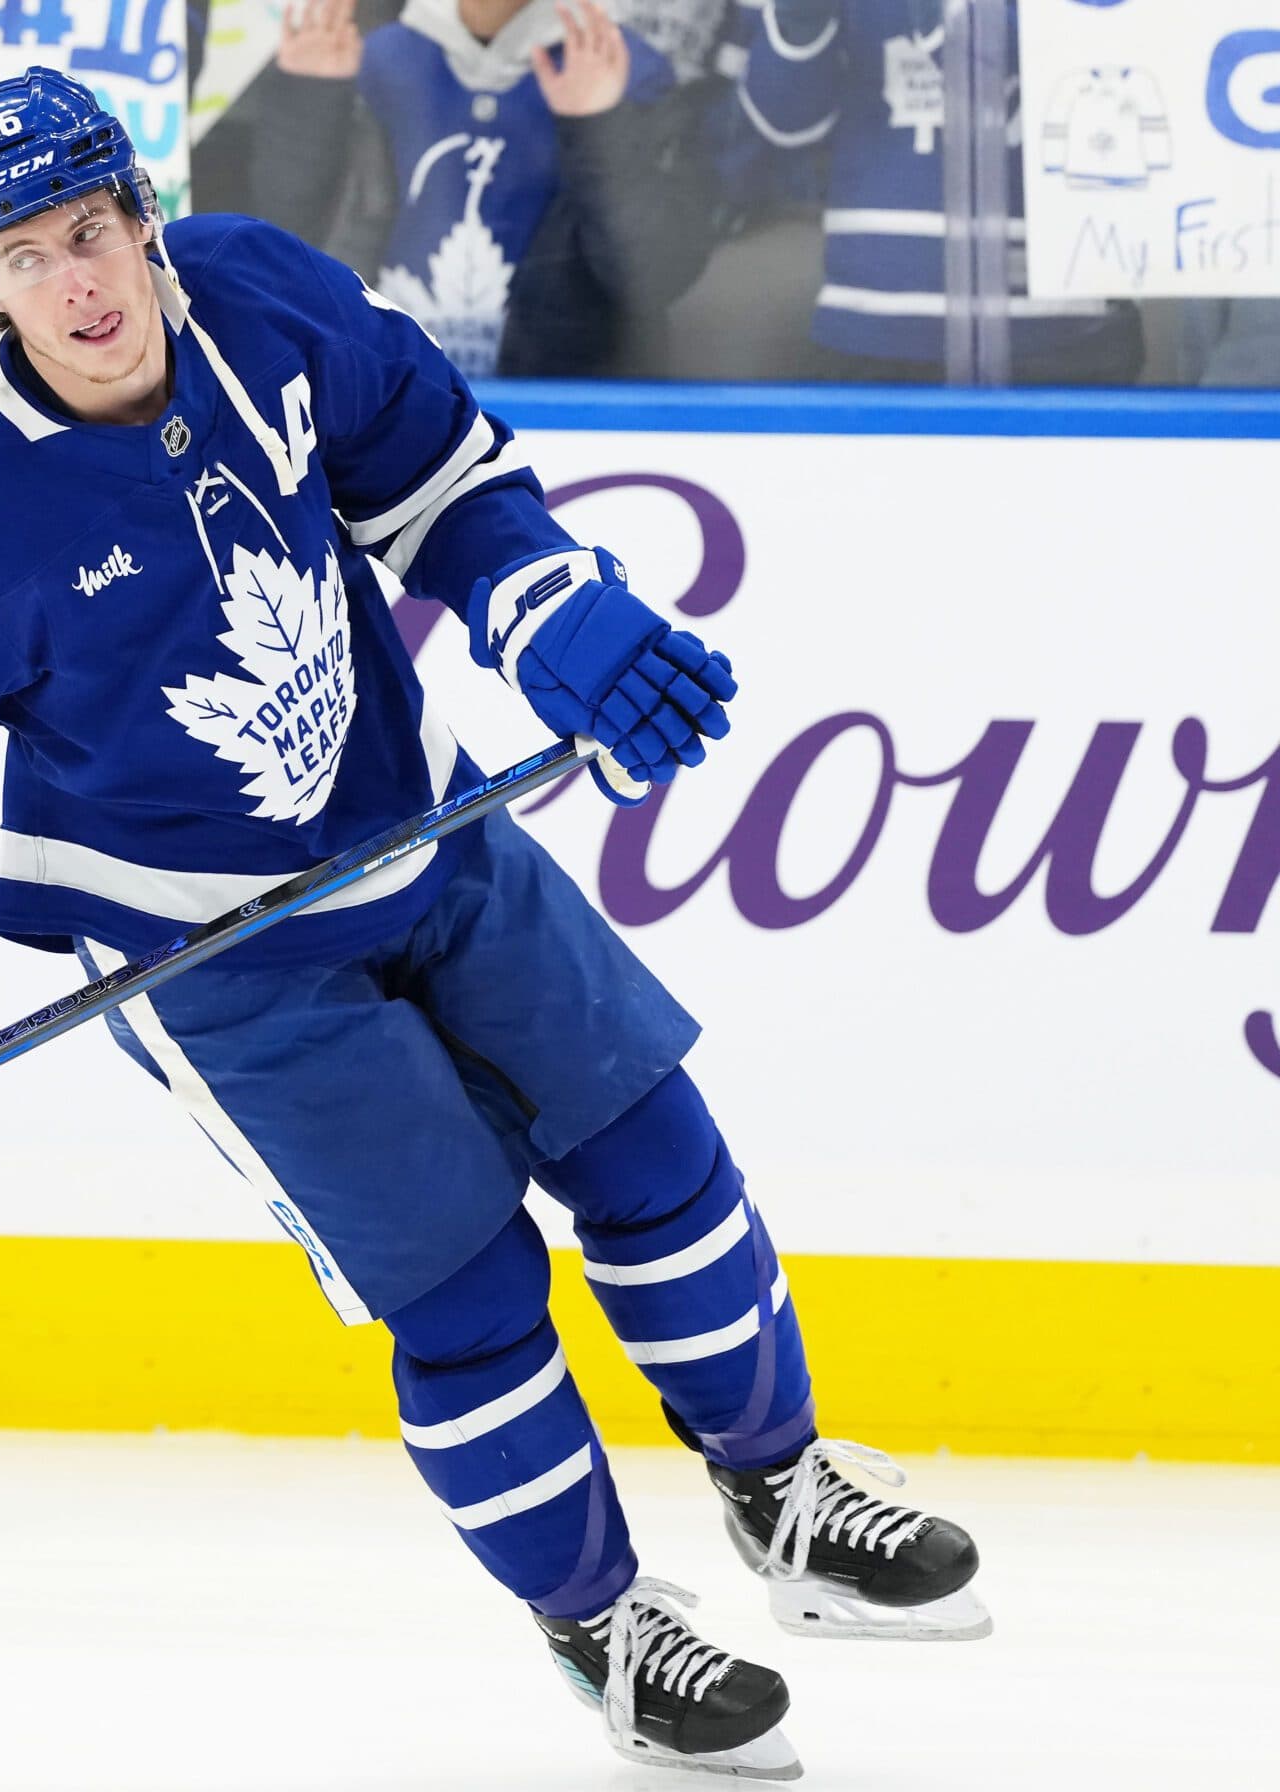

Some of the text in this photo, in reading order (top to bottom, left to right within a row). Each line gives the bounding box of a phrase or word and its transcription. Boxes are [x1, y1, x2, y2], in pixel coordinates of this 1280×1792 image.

[237, 629, 344, 746] TORONTO
[272, 666, 343, 759] MAPLE
[283, 695, 347, 786] LEAFS
[422, 754, 554, 818] TRUE
